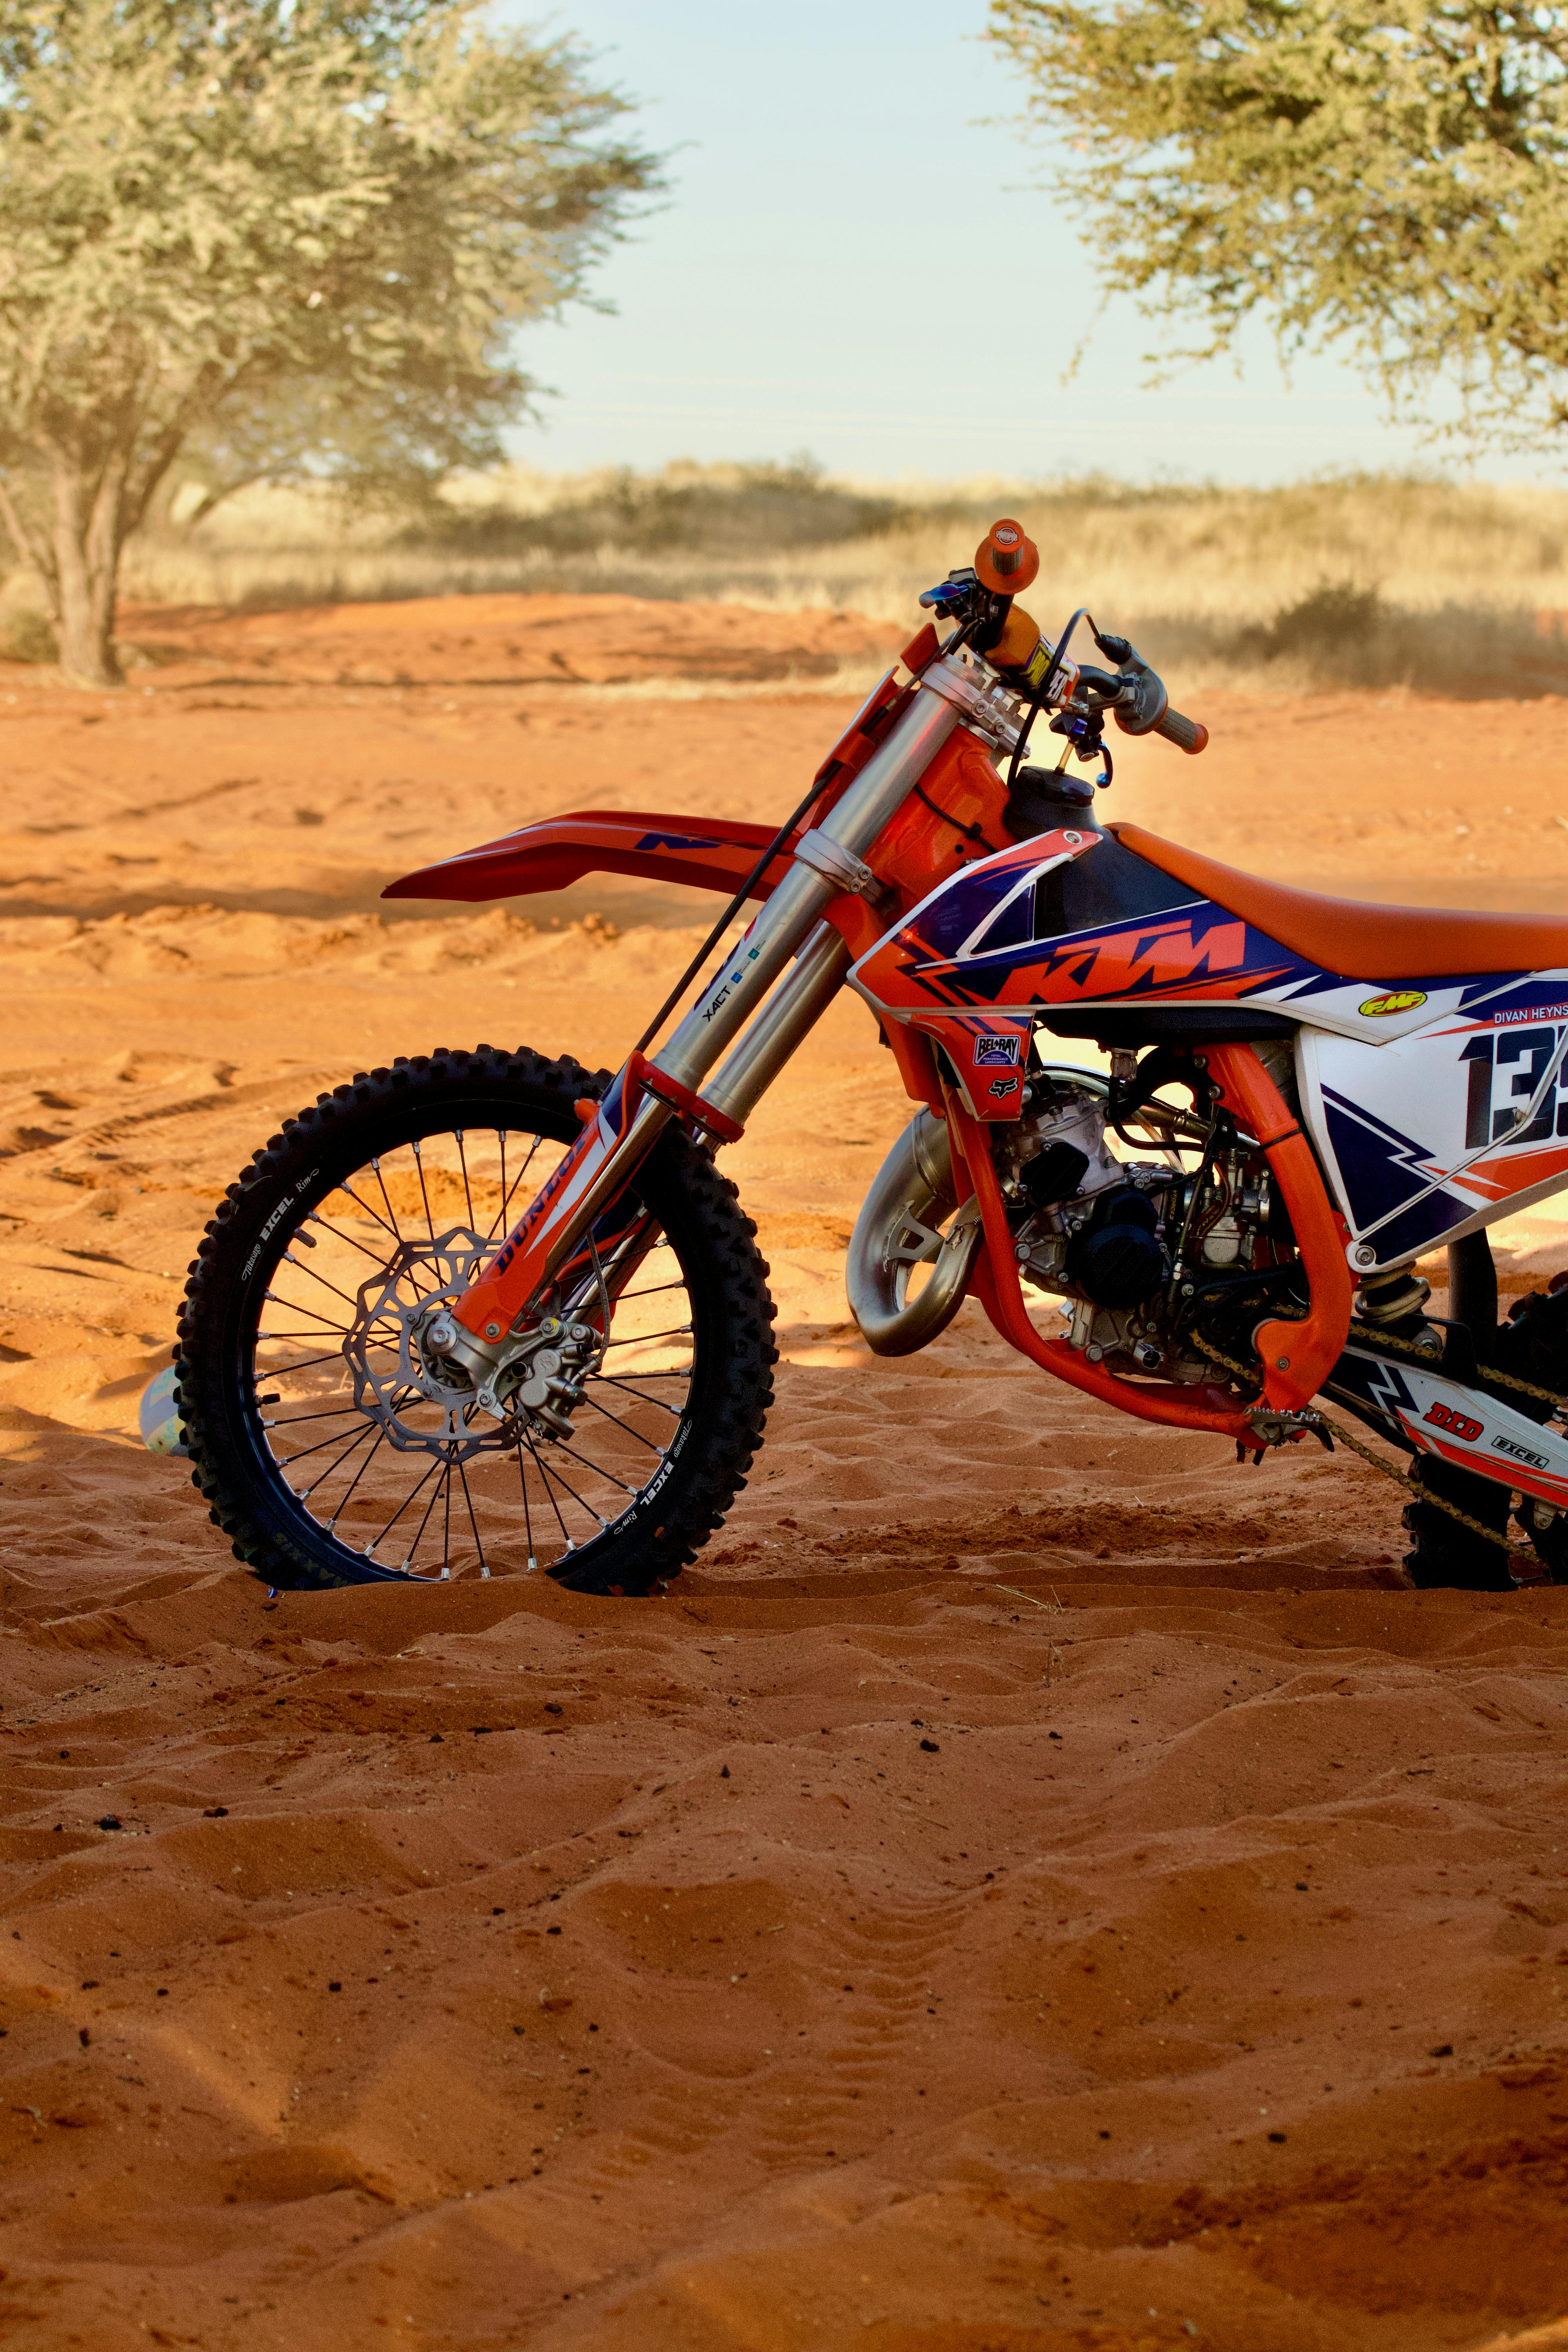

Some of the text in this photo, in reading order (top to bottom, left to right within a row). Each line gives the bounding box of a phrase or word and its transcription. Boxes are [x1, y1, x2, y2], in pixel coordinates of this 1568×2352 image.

[992, 919, 1246, 1004] KTM
[702, 985, 731, 1022] XACT
[1363, 992, 1423, 1015] FMF
[1494, 1005, 1568, 1024] DIVAN HEYNS
[1458, 1025, 1568, 1150] 13
[242, 1169, 319, 1281] Takasago EXCEL Rim
[614, 1420, 692, 1534] Takasago EXCEL Rim
[1496, 1439, 1544, 1467] EXCEL
